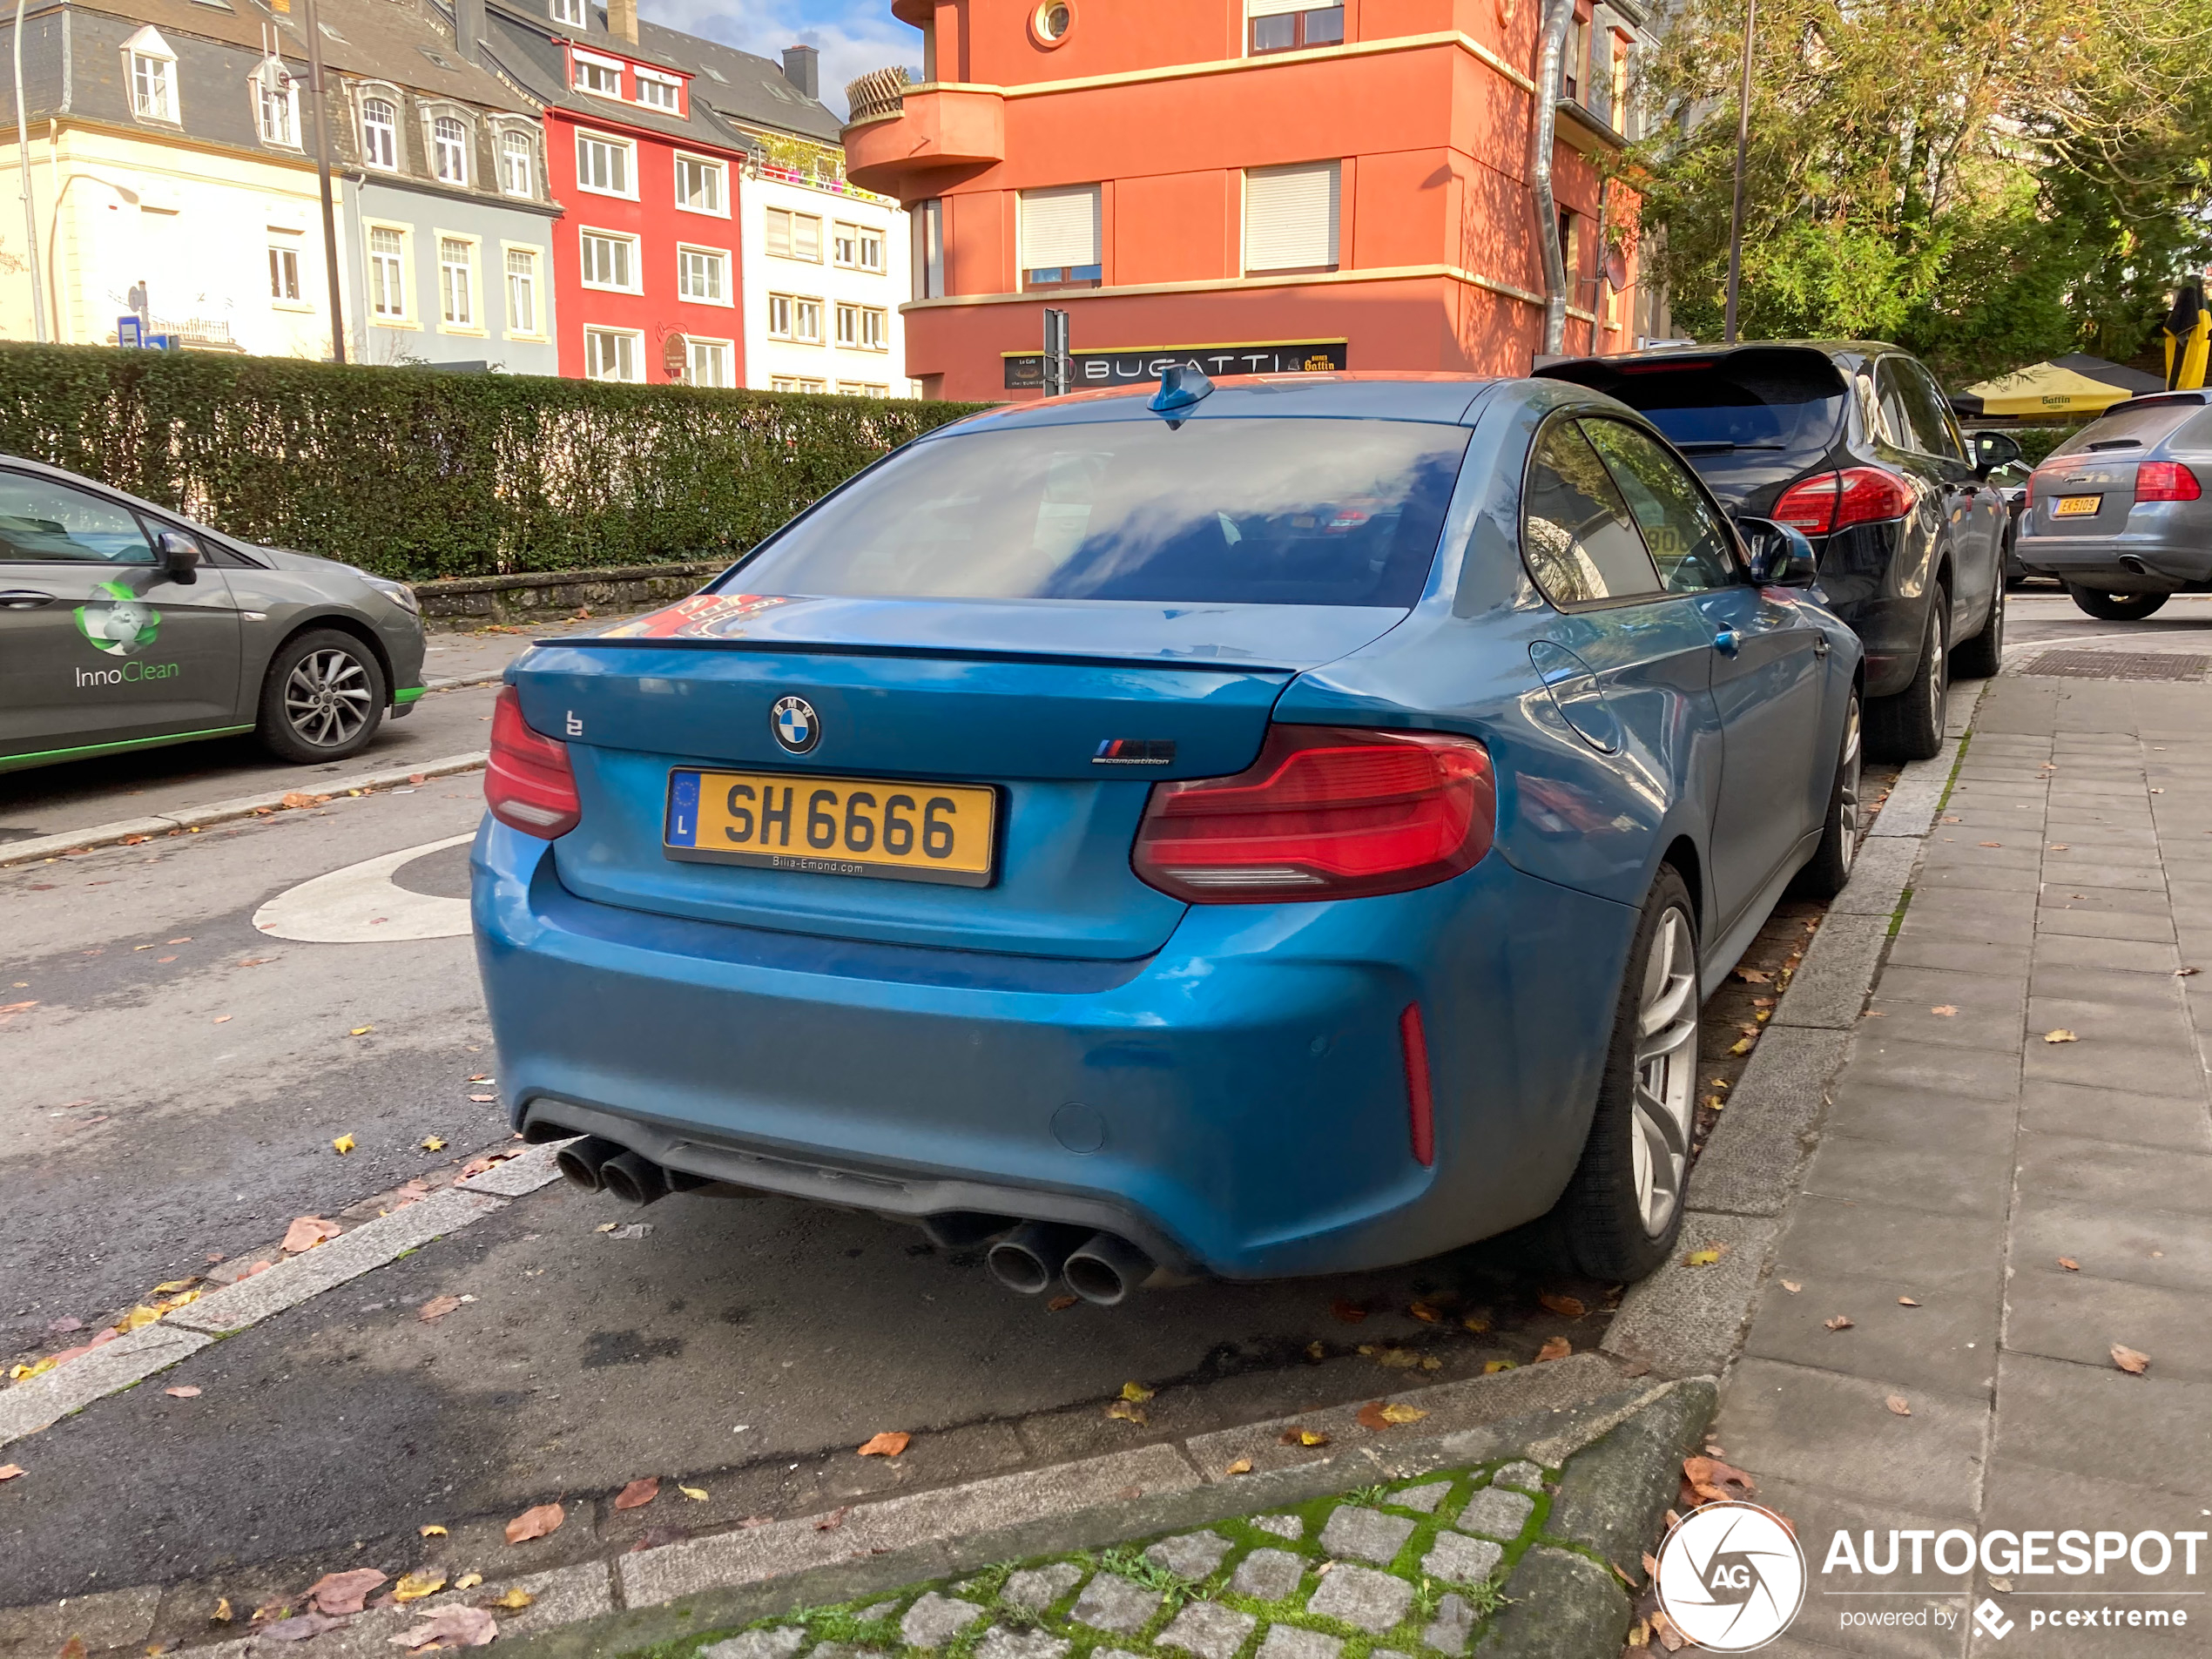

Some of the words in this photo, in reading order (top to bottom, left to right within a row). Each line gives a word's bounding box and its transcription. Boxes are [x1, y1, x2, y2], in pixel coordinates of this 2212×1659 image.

[1084, 353, 1279, 379] BUGATTI
[1304, 359, 1335, 371] Battin
[2041, 395, 2071, 405] Battin
[2061, 500, 2074, 512] EK
[2073, 499, 2095, 511] 5109
[75, 660, 179, 688] InnoClean
[773, 698, 814, 718] BMW
[677, 815, 688, 834] L
[725, 784, 794, 846] SH
[806, 789, 957, 859] 6666
[772, 855, 863, 873] Bilia-Emond.com
